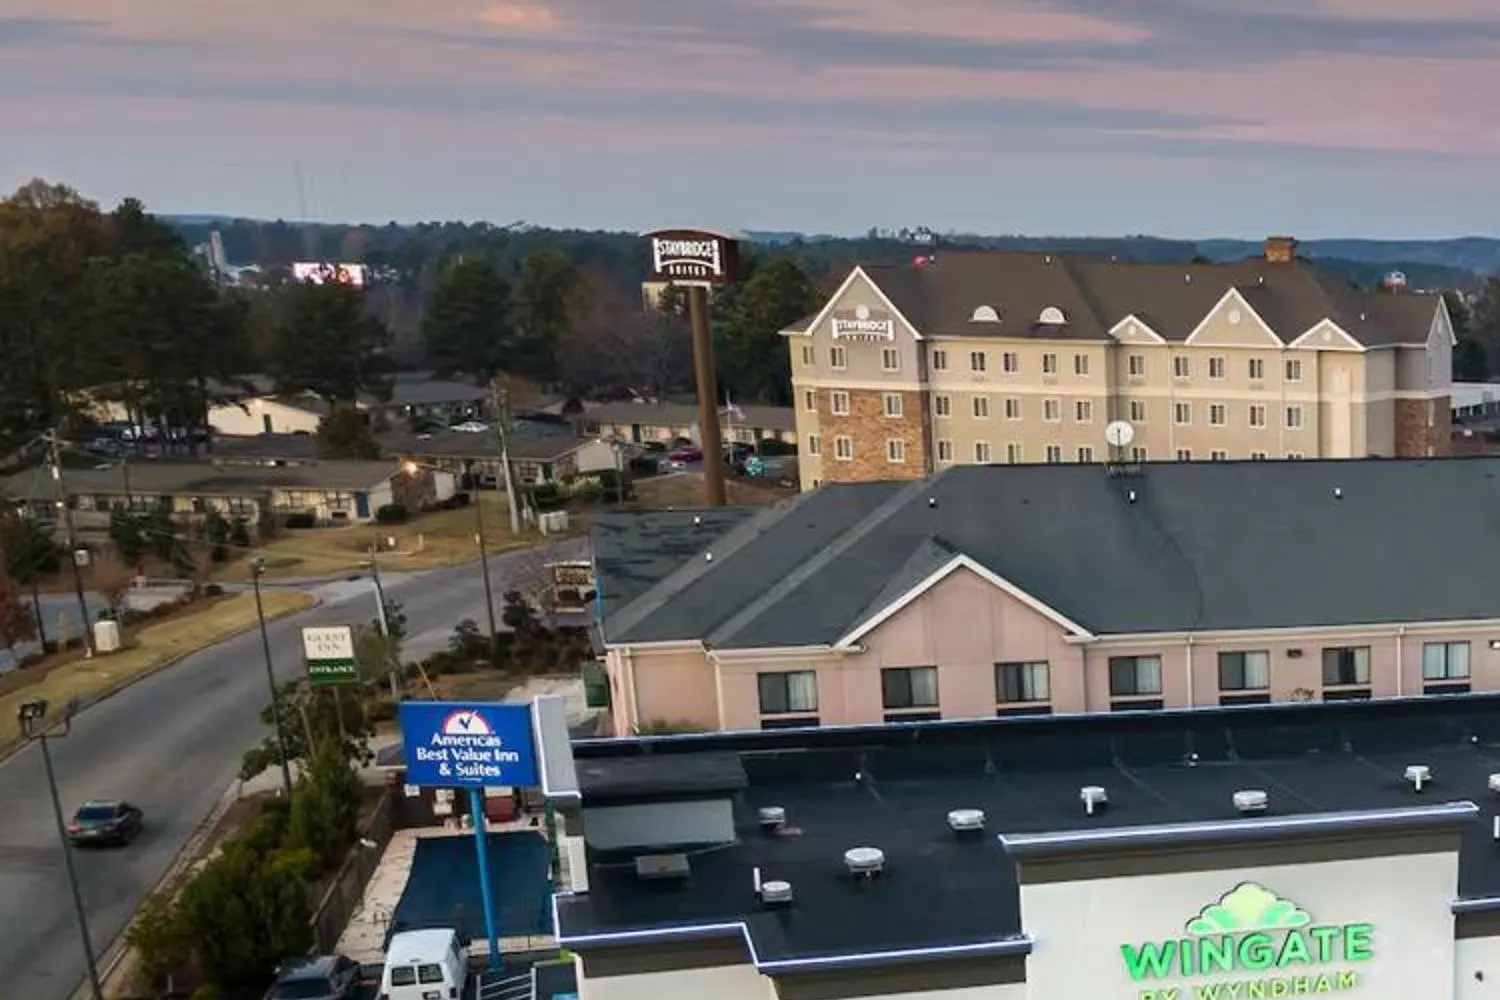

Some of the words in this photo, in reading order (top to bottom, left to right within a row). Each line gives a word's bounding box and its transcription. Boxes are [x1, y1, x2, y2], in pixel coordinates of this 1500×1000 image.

[659, 239, 713, 257] STAYBRIDGE
[431, 731, 502, 747] Americas
[416, 747, 449, 761] Best
[450, 747, 492, 761] Value
[494, 748, 519, 762] Inn
[439, 762, 451, 776] &
[455, 762, 501, 777] Suites
[1119, 922, 1375, 981] WINGATE
